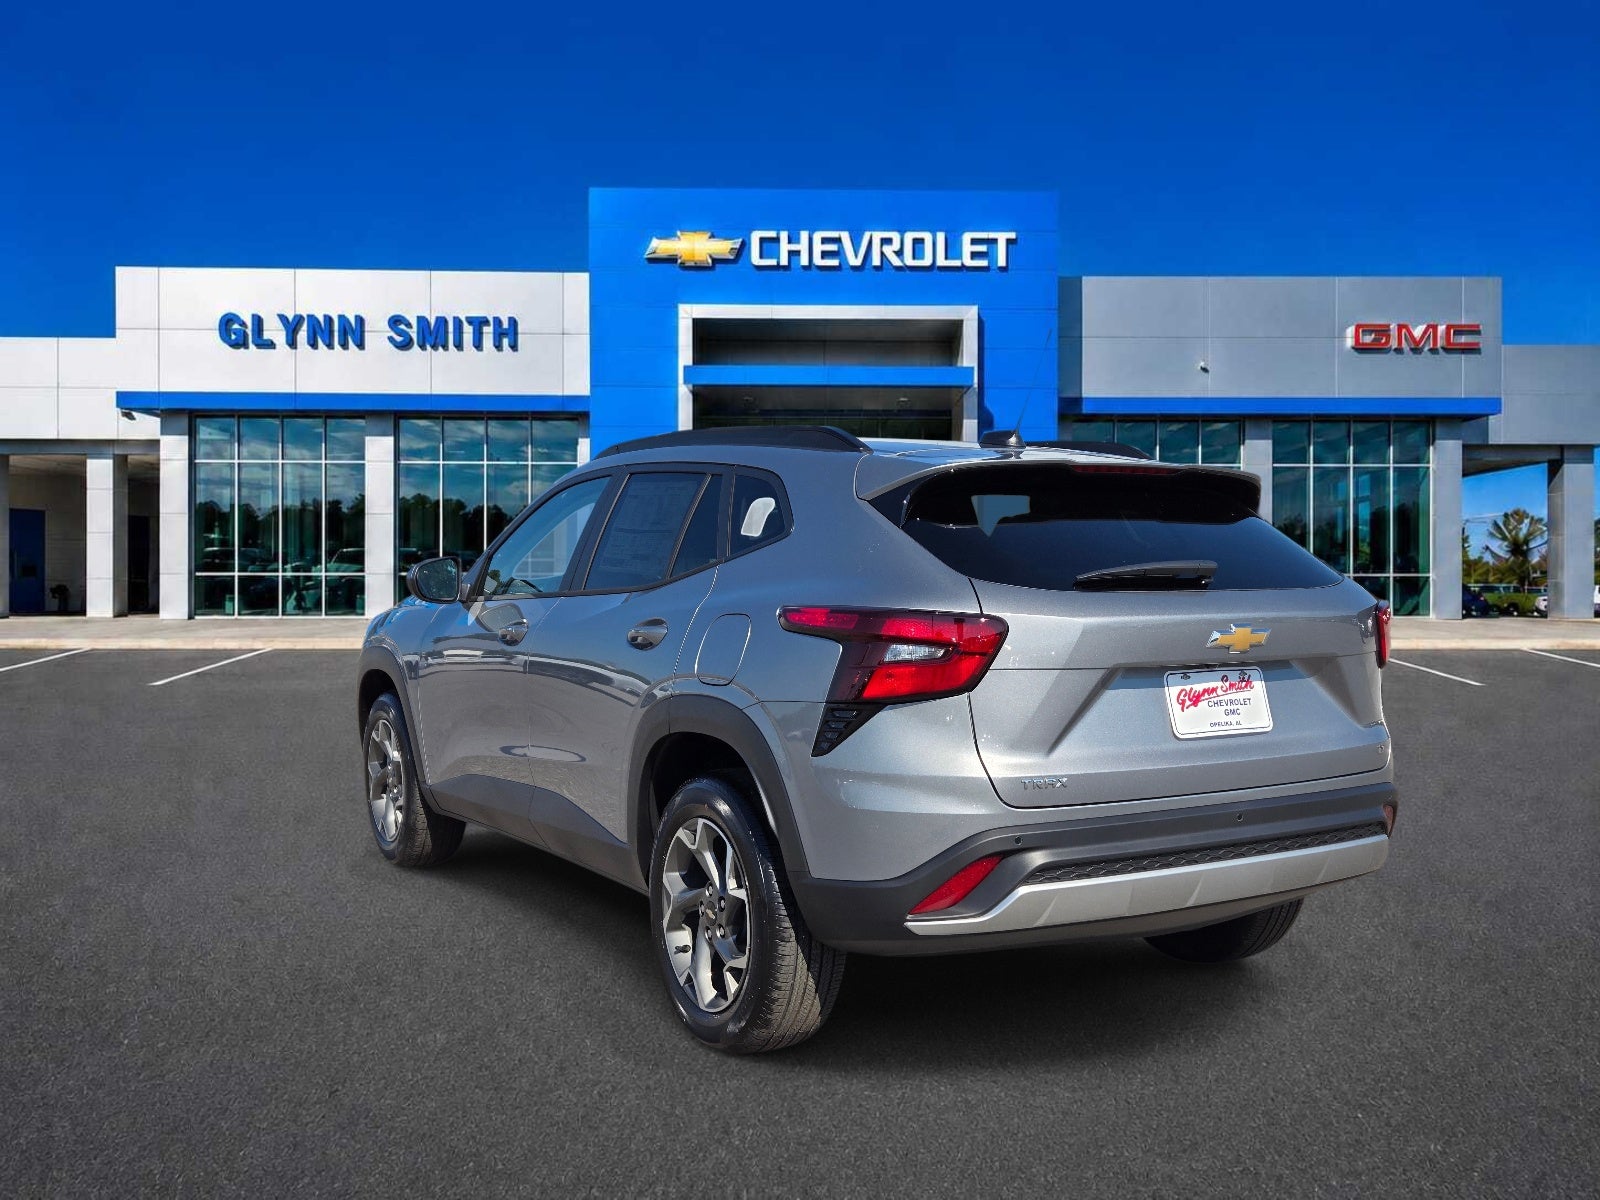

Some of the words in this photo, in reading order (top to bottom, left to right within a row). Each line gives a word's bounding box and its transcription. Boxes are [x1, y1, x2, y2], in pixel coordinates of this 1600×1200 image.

[750, 230, 1017, 269] CHEVROLET
[218, 312, 366, 350] GLYNN
[387, 314, 519, 352] SMITH
[1349, 322, 1482, 353] GMC
[1176, 685, 1219, 712] Glynn
[1220, 674, 1255, 693] Smith
[1207, 698, 1252, 708] CHEVROLET
[1224, 708, 1241, 716] GMC
[1021, 777, 1068, 790] TRAX
